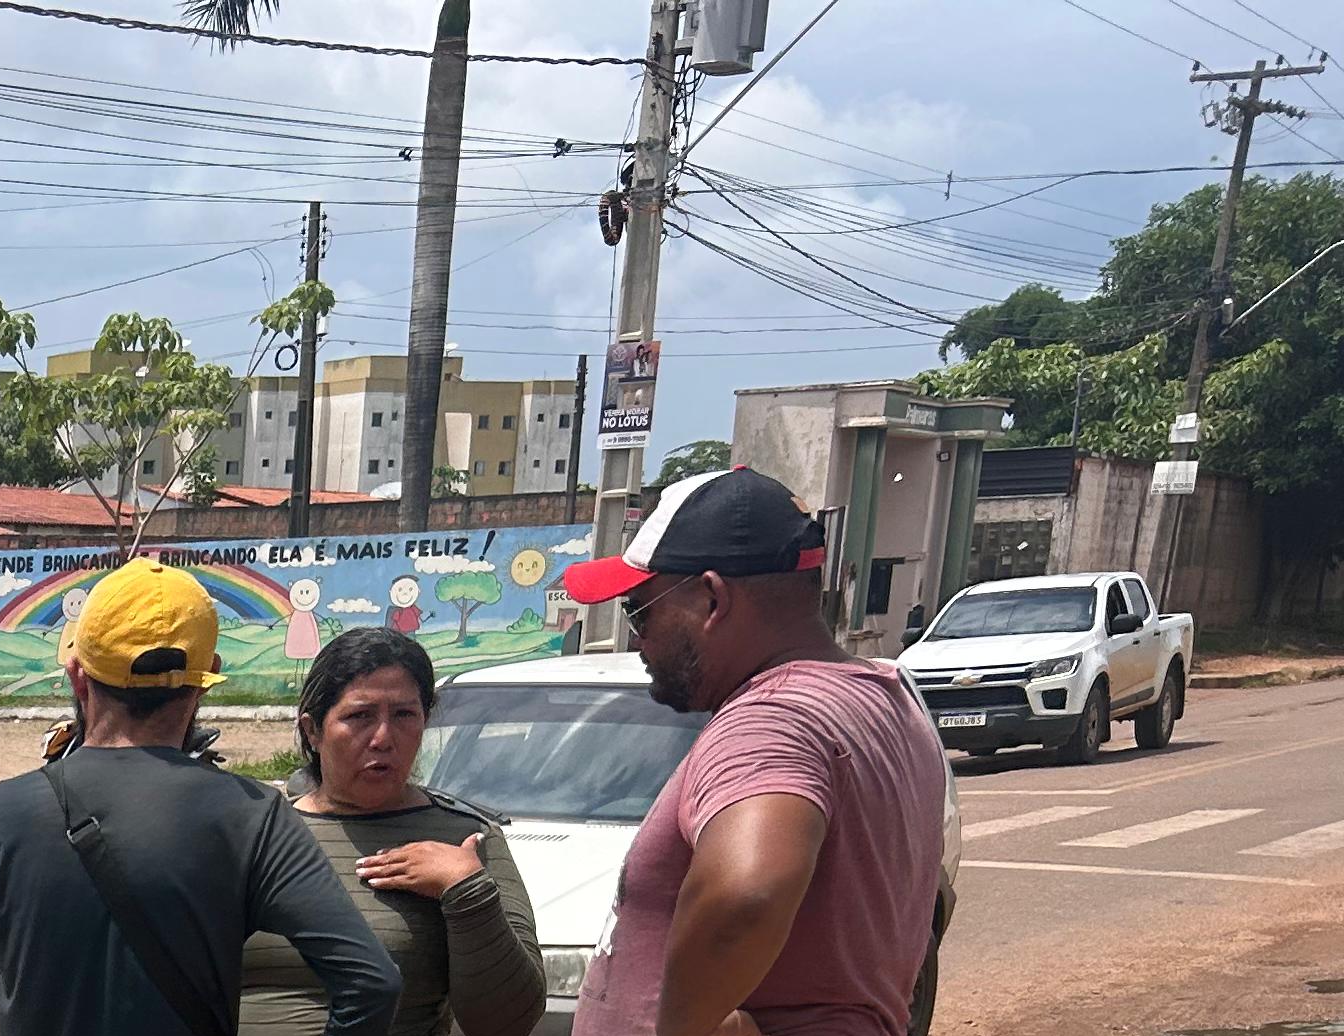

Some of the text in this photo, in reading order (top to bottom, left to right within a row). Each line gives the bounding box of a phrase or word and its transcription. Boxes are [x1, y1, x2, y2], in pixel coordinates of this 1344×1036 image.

[602, 417, 616, 429] NO
[43, 551, 124, 572] BRINCAND
[159, 547, 257, 568] BRINCANDO
[268, 545, 303, 564] ELA
[314, 539, 326, 562] É
[337, 540, 393, 560] MAIS
[405, 537, 469, 558] FELIZ
